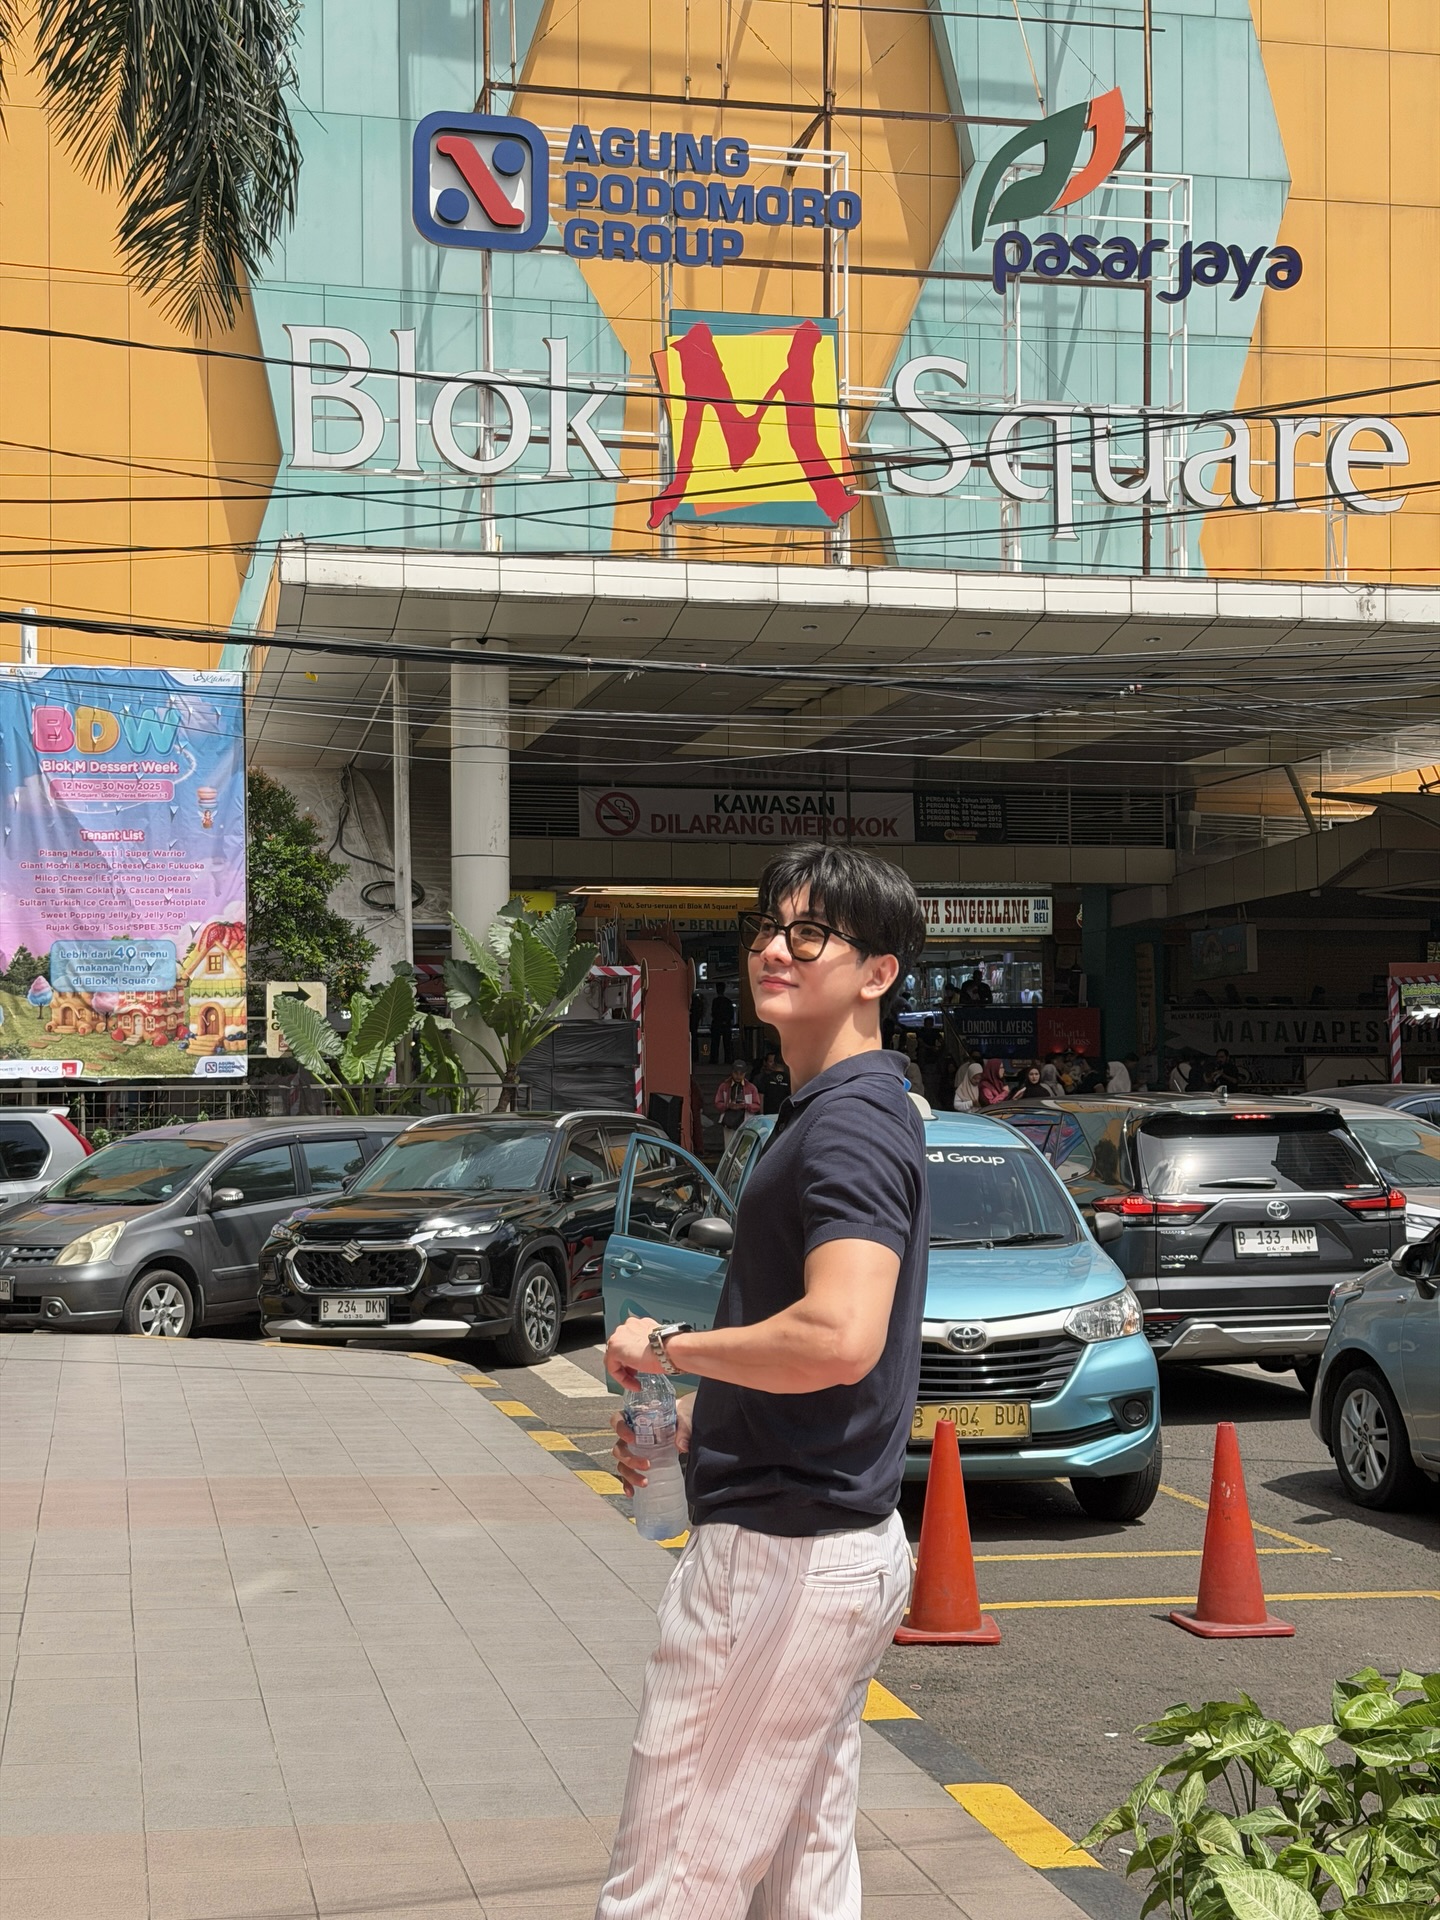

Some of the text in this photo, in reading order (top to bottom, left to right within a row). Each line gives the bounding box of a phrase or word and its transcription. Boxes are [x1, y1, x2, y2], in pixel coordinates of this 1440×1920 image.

[563, 124, 750, 178] AGUNG
[565, 170, 862, 230] PODOMORO
[564, 219, 744, 268] GROUP
[992, 230, 1303, 304] pasar jaya
[282, 320, 1410, 541] Blok M Square
[32, 706, 181, 754] BDW
[42, 762, 178, 774] Blok M Dessert Week
[63, 782, 160, 790] 12 Nov 30 Nov 2025
[713, 794, 836, 816] KAWASAN
[651, 814, 899, 838] DILARANG MEROKOK
[80, 830, 144, 842] Tenant List
[39, 850, 185, 858] Pisang Madu Pasti Super Warrior
[20, 862, 204, 870] Giant Mochi & Mochi Cheese Cake Fukuoka
[35, 874, 58, 883] Milop
[61, 874, 92, 883] Cheese
[102, 874, 110, 883] Es
[113, 874, 141, 883] Pisang
[144, 874, 155, 883] Ijo
[35, 887, 191, 895] Cake Siram Coklat by Cascana Meals
[620, 902, 635, 910] Yuk,
[712, 903, 738, 912] Square!
[1033, 899, 1049, 910] JUAL
[41, 911, 186, 920] Sweet Popping Jelly by Jelly Pop!
[945, 900, 1030, 924] SINGGALANG
[1034, 912, 1048, 923] BELI
[46, 924, 70, 932] Rujak
[72, 924, 100, 932] Geboy
[109, 924, 131, 932] Sosis
[158, 924, 182, 932] 35cm
[690, 920, 738, 930] BERLIA
[60, 951, 87, 959] Lebih
[92, 951, 111, 959] dari
[114, 946, 136, 960] 40
[123, 964, 153, 973] hanya
[72, 977, 81, 985] di
[85, 977, 107, 985] Blok
[122, 977, 156, 986] Square
[962, 1020, 1033, 1034] LONDON LAYERS
[1048, 1020, 1064, 1029] The
[947, 1153, 1005, 1166] Group
[1238, 1229, 1314, 1246] B 133 ANP
[323, 1300, 385, 1313] B 234 DKN
[914, 1406, 1026, 1428] B 2004 BUA
